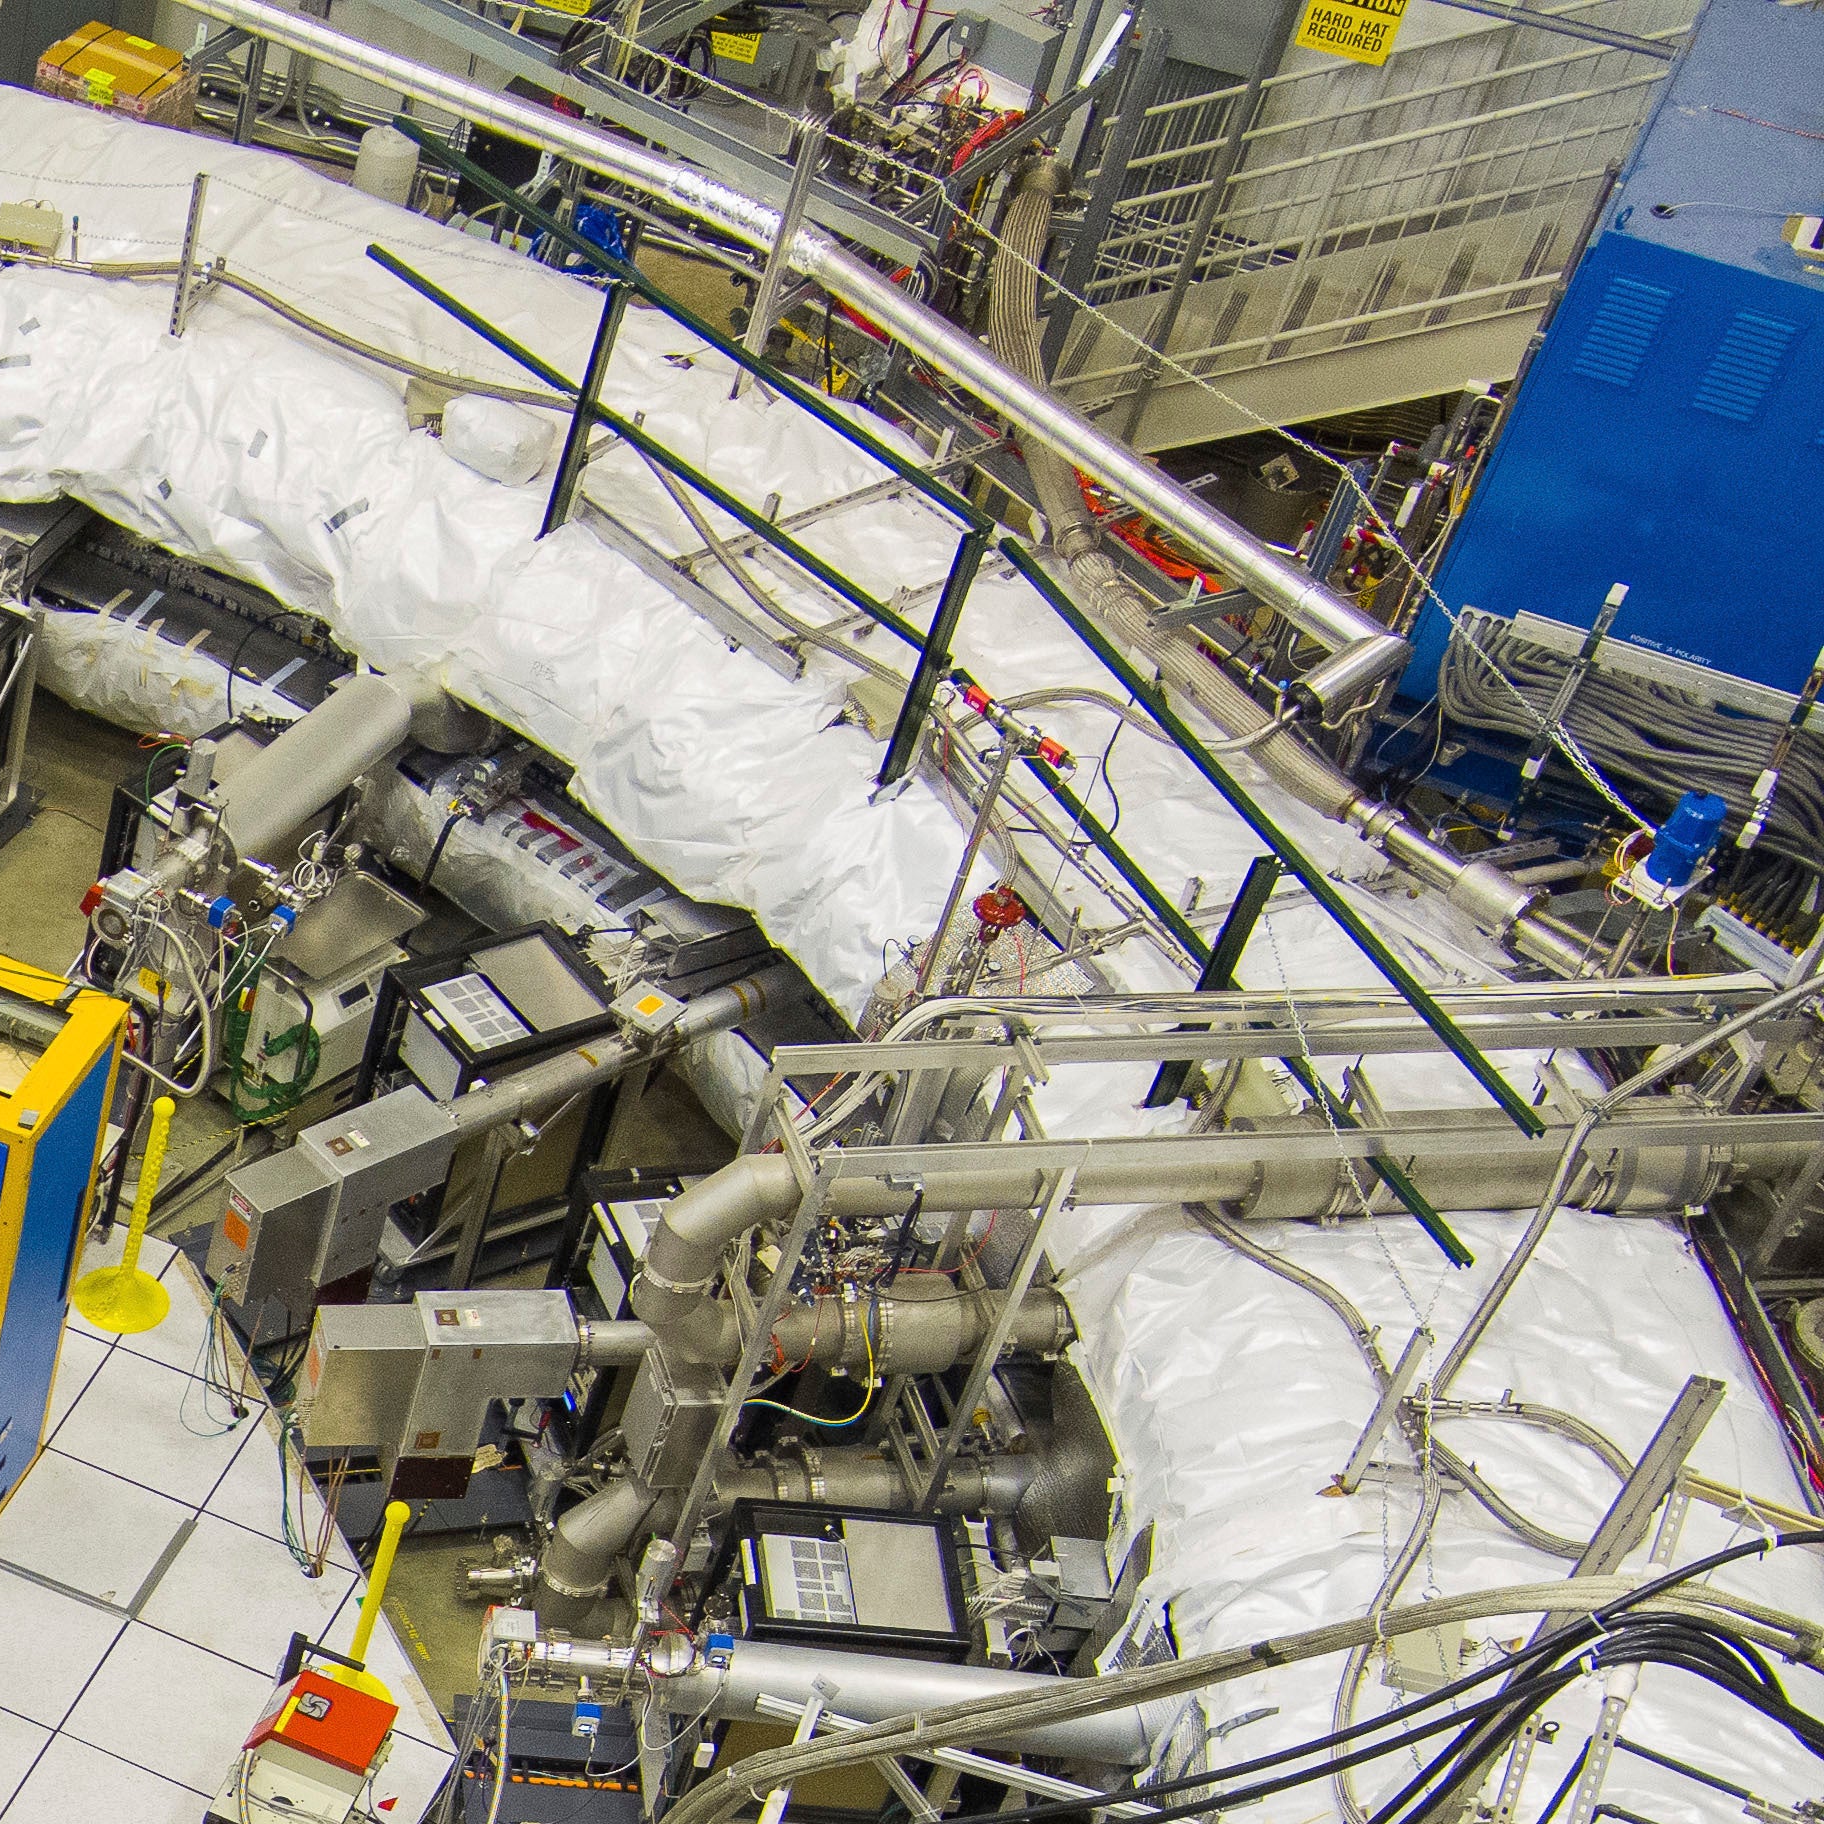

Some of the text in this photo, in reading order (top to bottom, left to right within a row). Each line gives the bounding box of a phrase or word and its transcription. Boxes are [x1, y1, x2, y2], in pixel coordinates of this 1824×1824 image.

[1307, 22, 1384, 54] REQUIRED
[1310, 7, 1391, 38] HARD HAT
